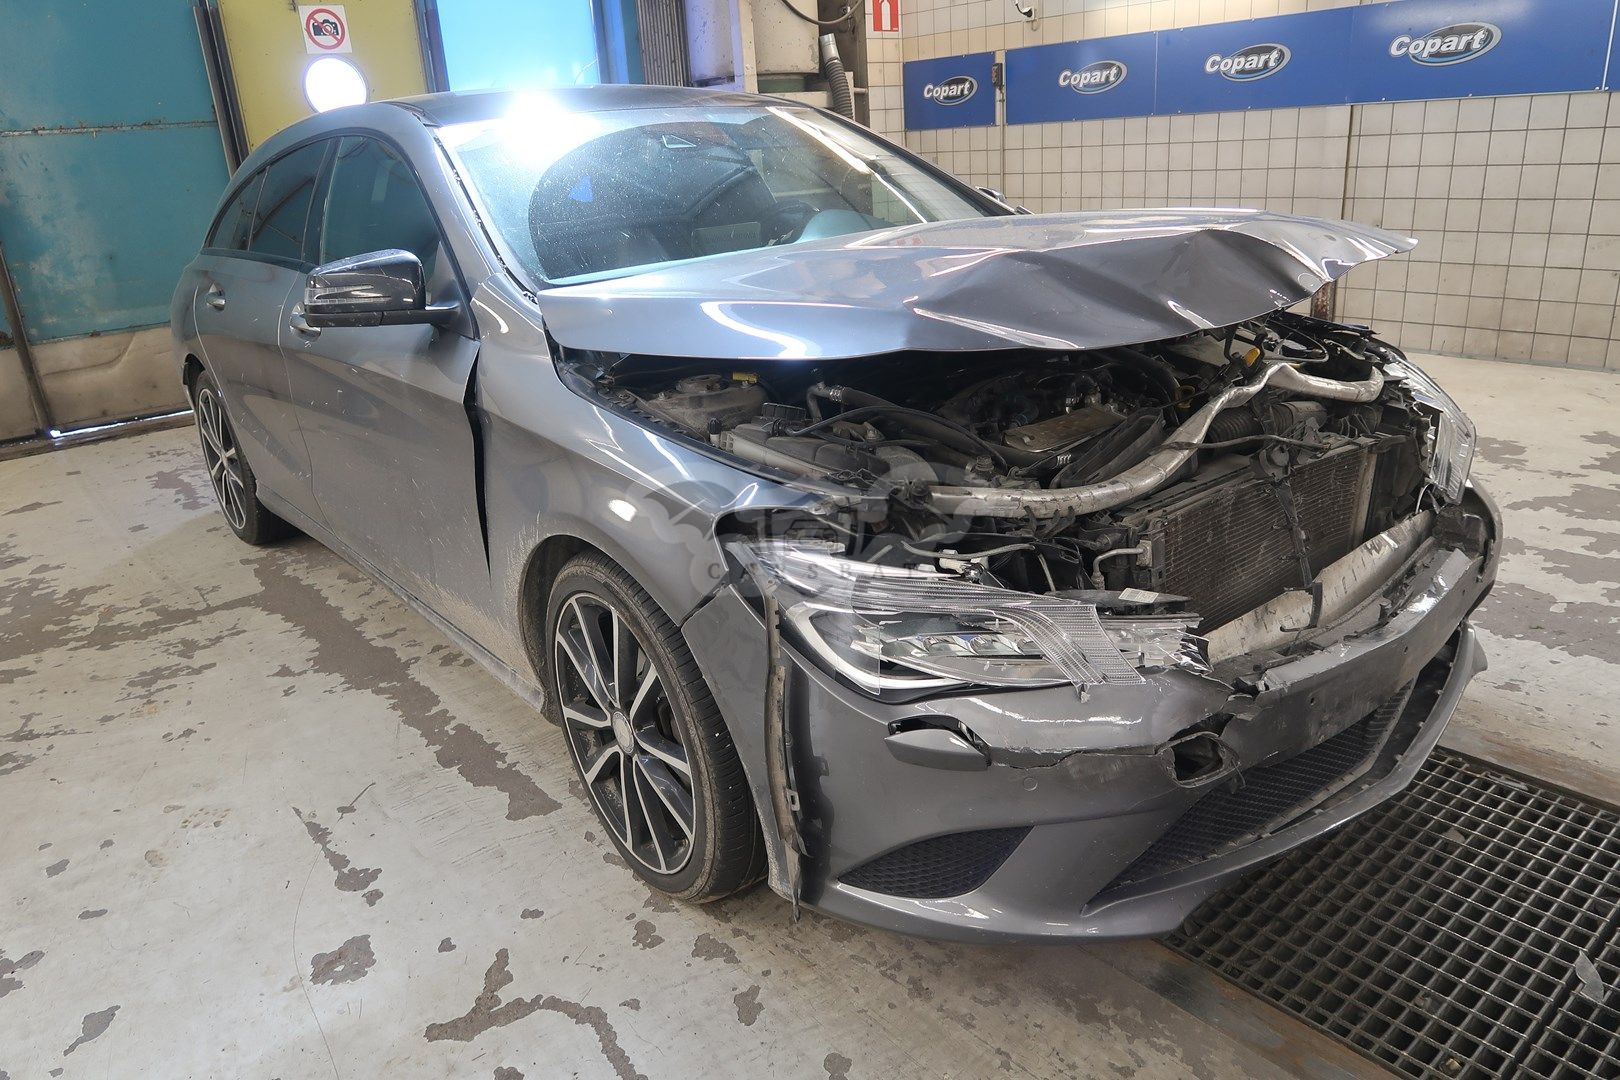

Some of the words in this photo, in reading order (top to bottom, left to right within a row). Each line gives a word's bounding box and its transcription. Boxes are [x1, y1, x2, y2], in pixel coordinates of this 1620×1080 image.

[1390, 29, 1486, 58] Copart
[1205, 49, 1280, 75] Copart
[1058, 66, 1118, 88] Copart
[923, 79, 970, 100] Copart
